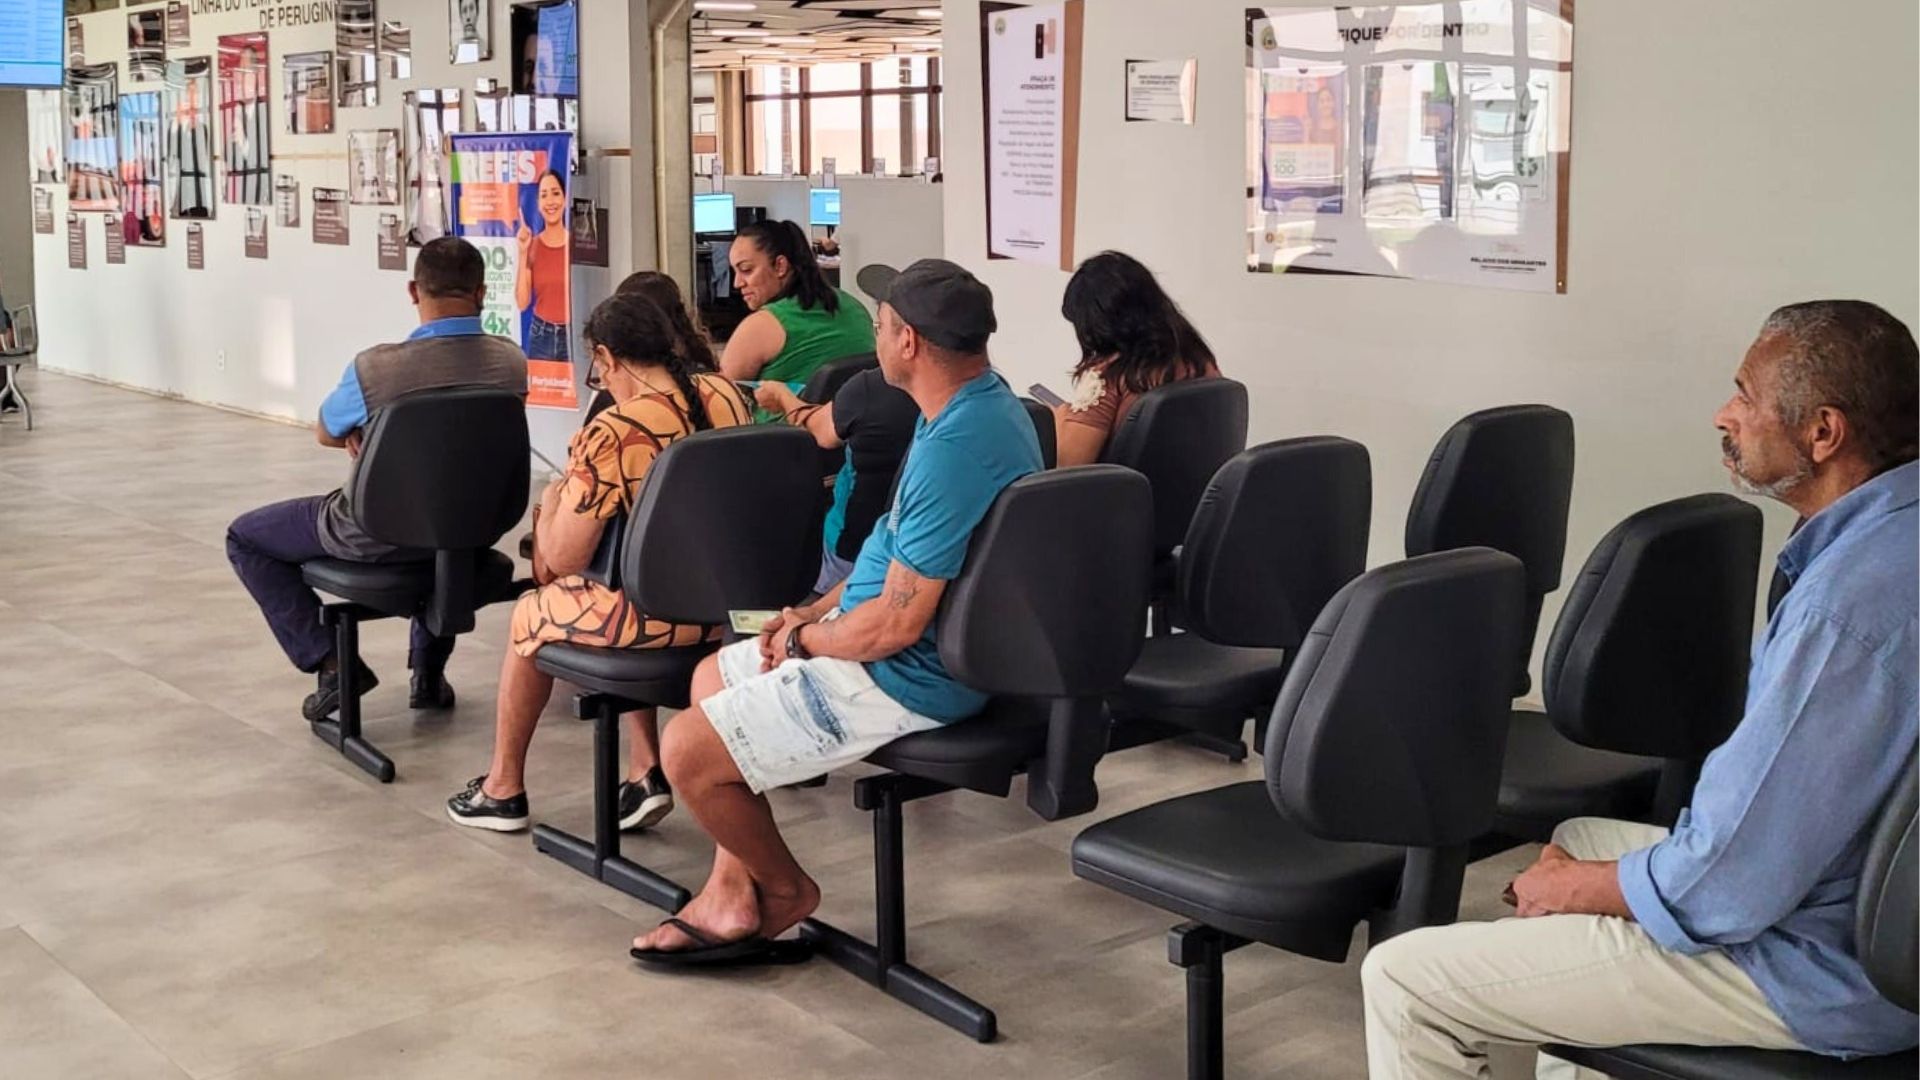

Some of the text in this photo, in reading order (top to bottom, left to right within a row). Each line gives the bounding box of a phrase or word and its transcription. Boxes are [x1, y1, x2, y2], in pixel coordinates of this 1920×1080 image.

[260, 1, 333, 28] DE PERUGIN
[1338, 27, 1383, 44] FIQUE
[1421, 22, 1489, 39] DENTRO
[461, 150, 537, 184] REFIS
